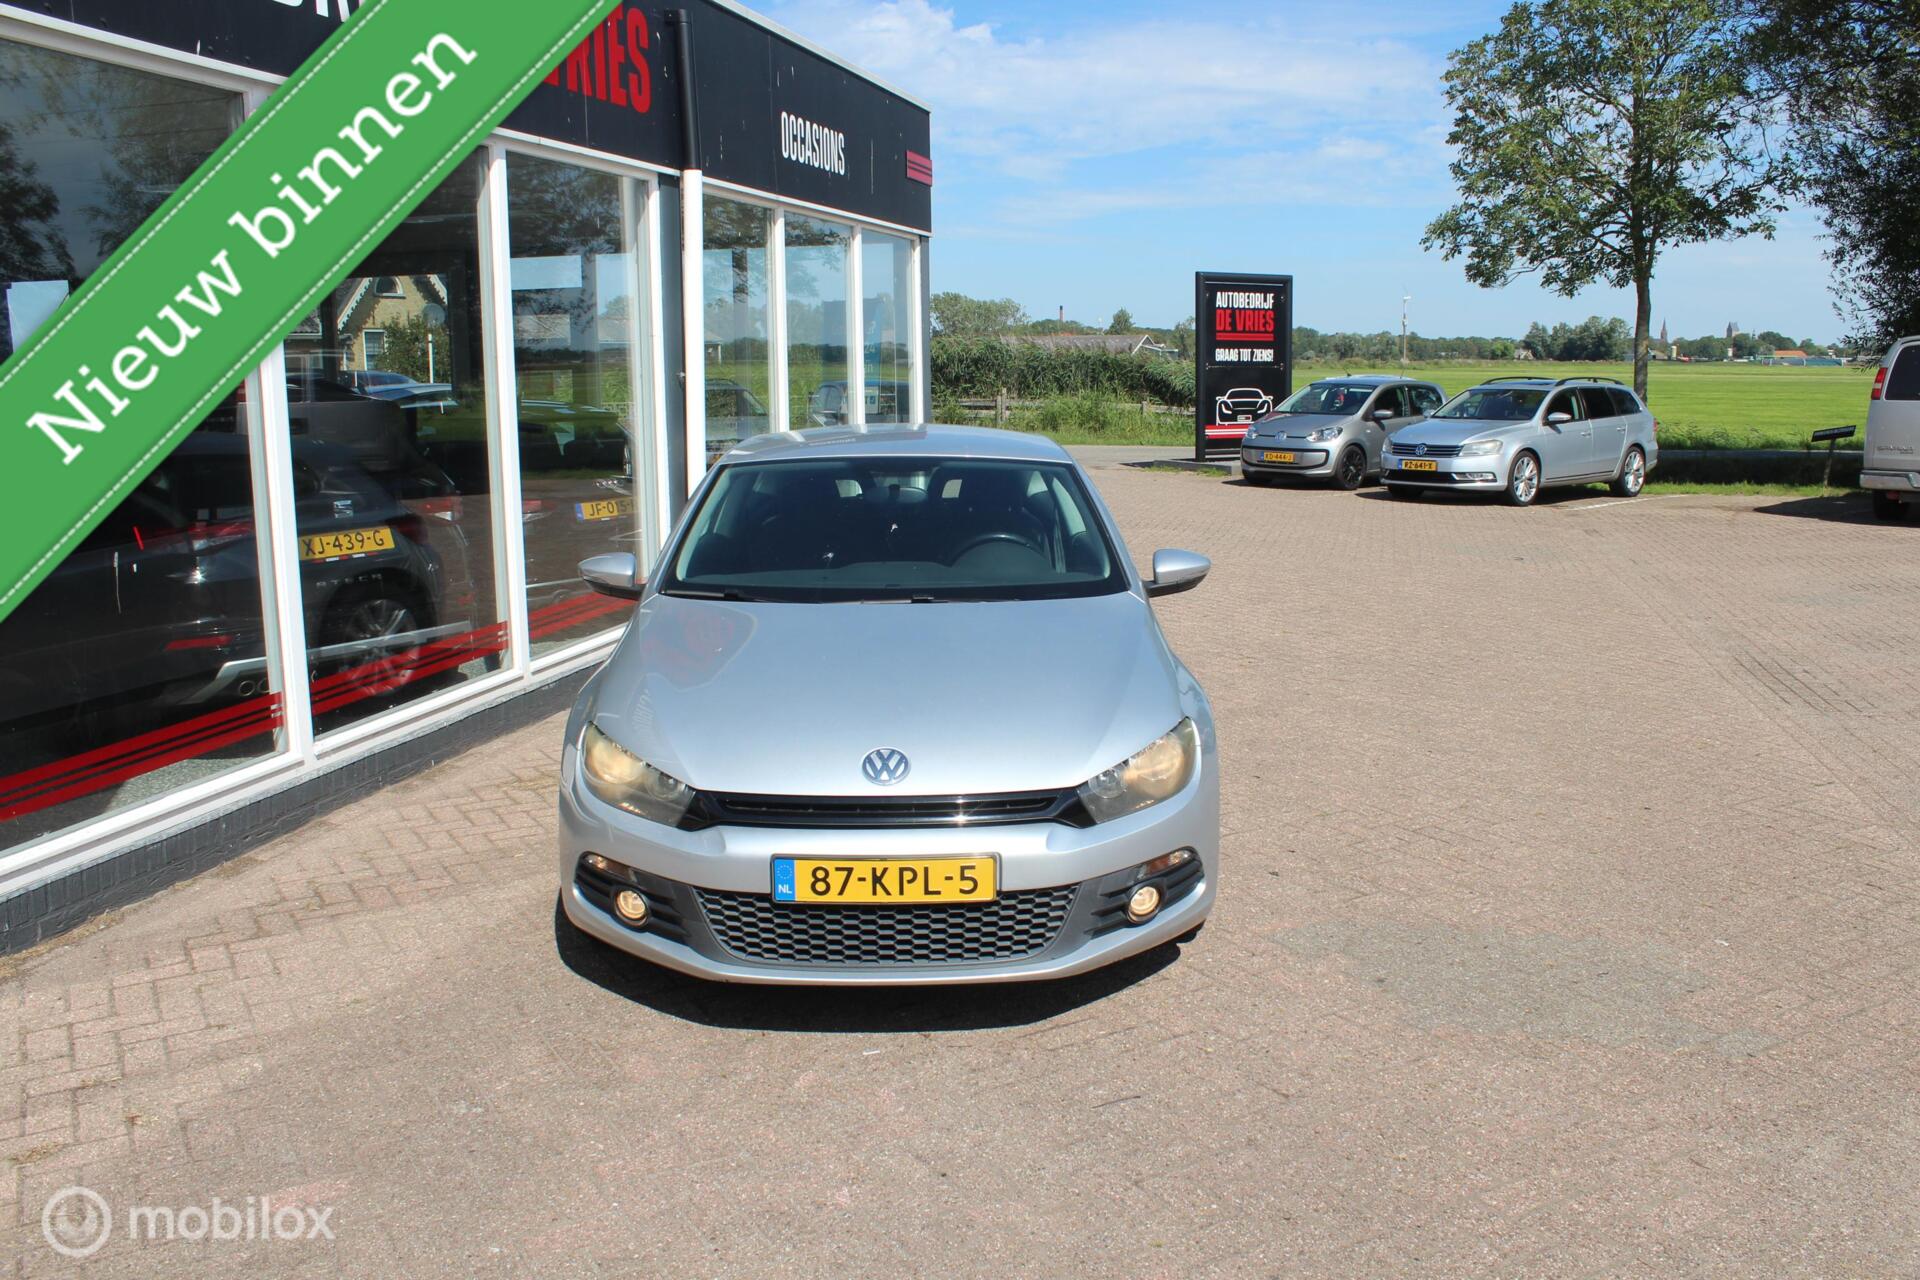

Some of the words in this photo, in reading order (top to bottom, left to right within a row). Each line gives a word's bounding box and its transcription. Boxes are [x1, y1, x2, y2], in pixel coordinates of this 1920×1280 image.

[781, 111, 845, 176] OCCASIONS
[1216, 291, 1275, 309] AUTOBEDRIJF
[1216, 309, 1232, 331] DE
[1236, 310, 1275, 332] VRIES
[1215, 348, 1239, 362] GRAAG
[1240, 348, 1251, 362] TOT
[1252, 348, 1274, 362] ZIENS!
[302, 530, 385, 556] XJ-439-G
[778, 884, 792, 894] NL
[810, 865, 979, 897] 87-KPL-5
